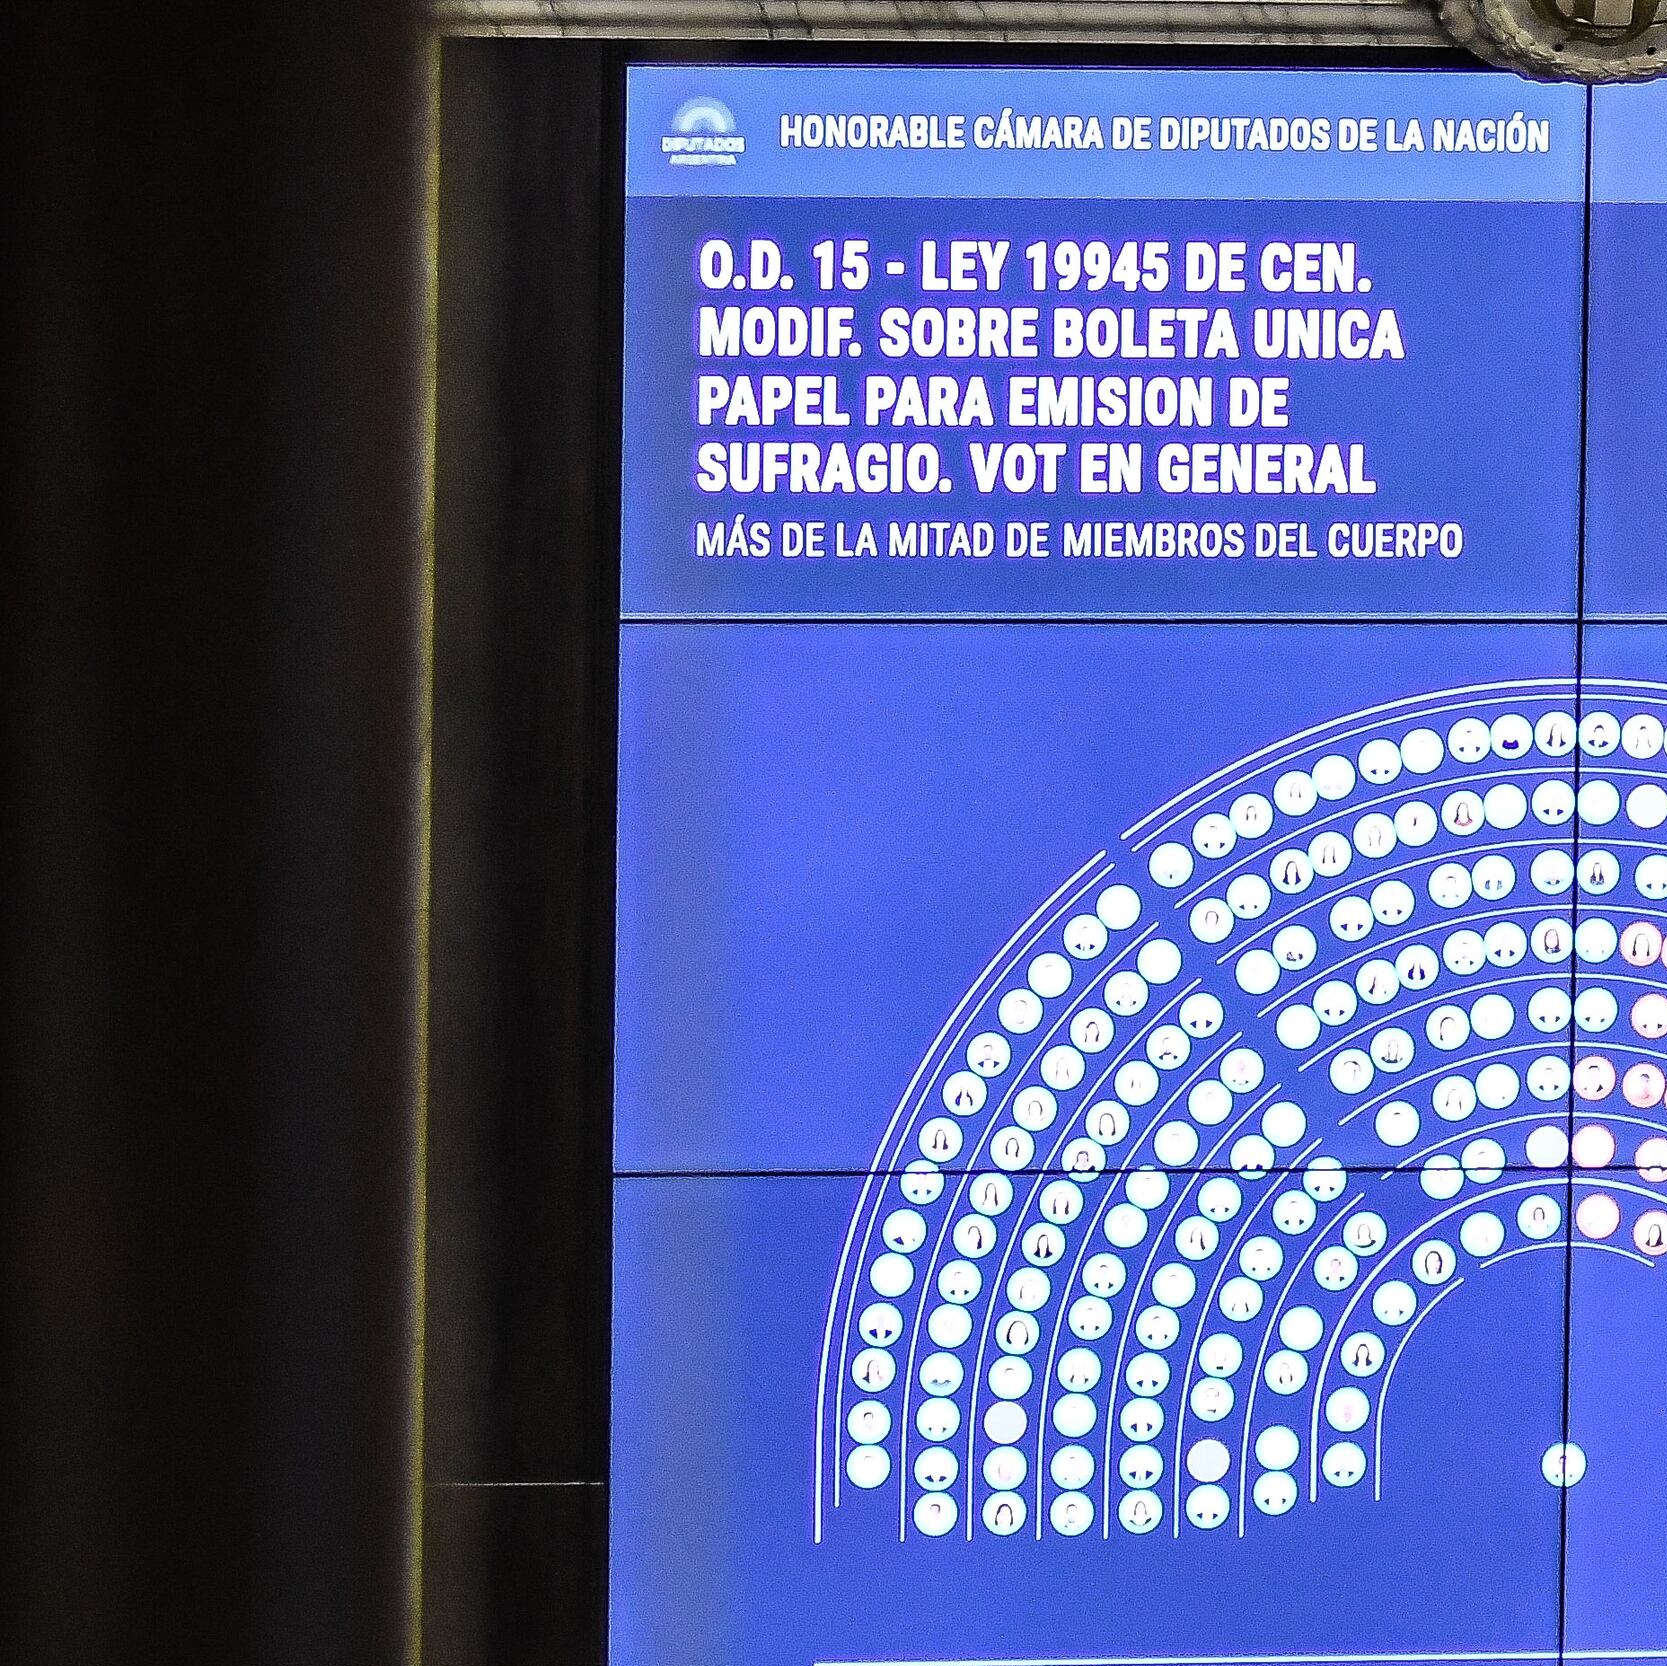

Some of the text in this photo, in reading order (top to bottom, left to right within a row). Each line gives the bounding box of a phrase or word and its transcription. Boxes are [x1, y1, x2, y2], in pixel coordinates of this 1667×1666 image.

[779, 108, 1550, 153] HONORABLE CÁMARA DE DIPUTADOS DE LA NACIÓN
[699, 240, 795, 291] O.D.
[814, 240, 870, 291] 15
[922, 240, 1011, 292] LEY
[1025, 241, 1170, 293] 19945
[1185, 242, 1248, 293] DE
[1260, 243, 1373, 294] CEN.
[699, 306, 1406, 360] MODIF. SOBRE BOLETA UNICA
[698, 375, 1291, 428] PAPEL PARA EMISION DE
[696, 442, 1378, 495] SUFRAGIO. VOT EN GENERAL
[695, 513, 1464, 559] MÁS DE LA MITAD DE MIEMBROS DEL CUERPO
